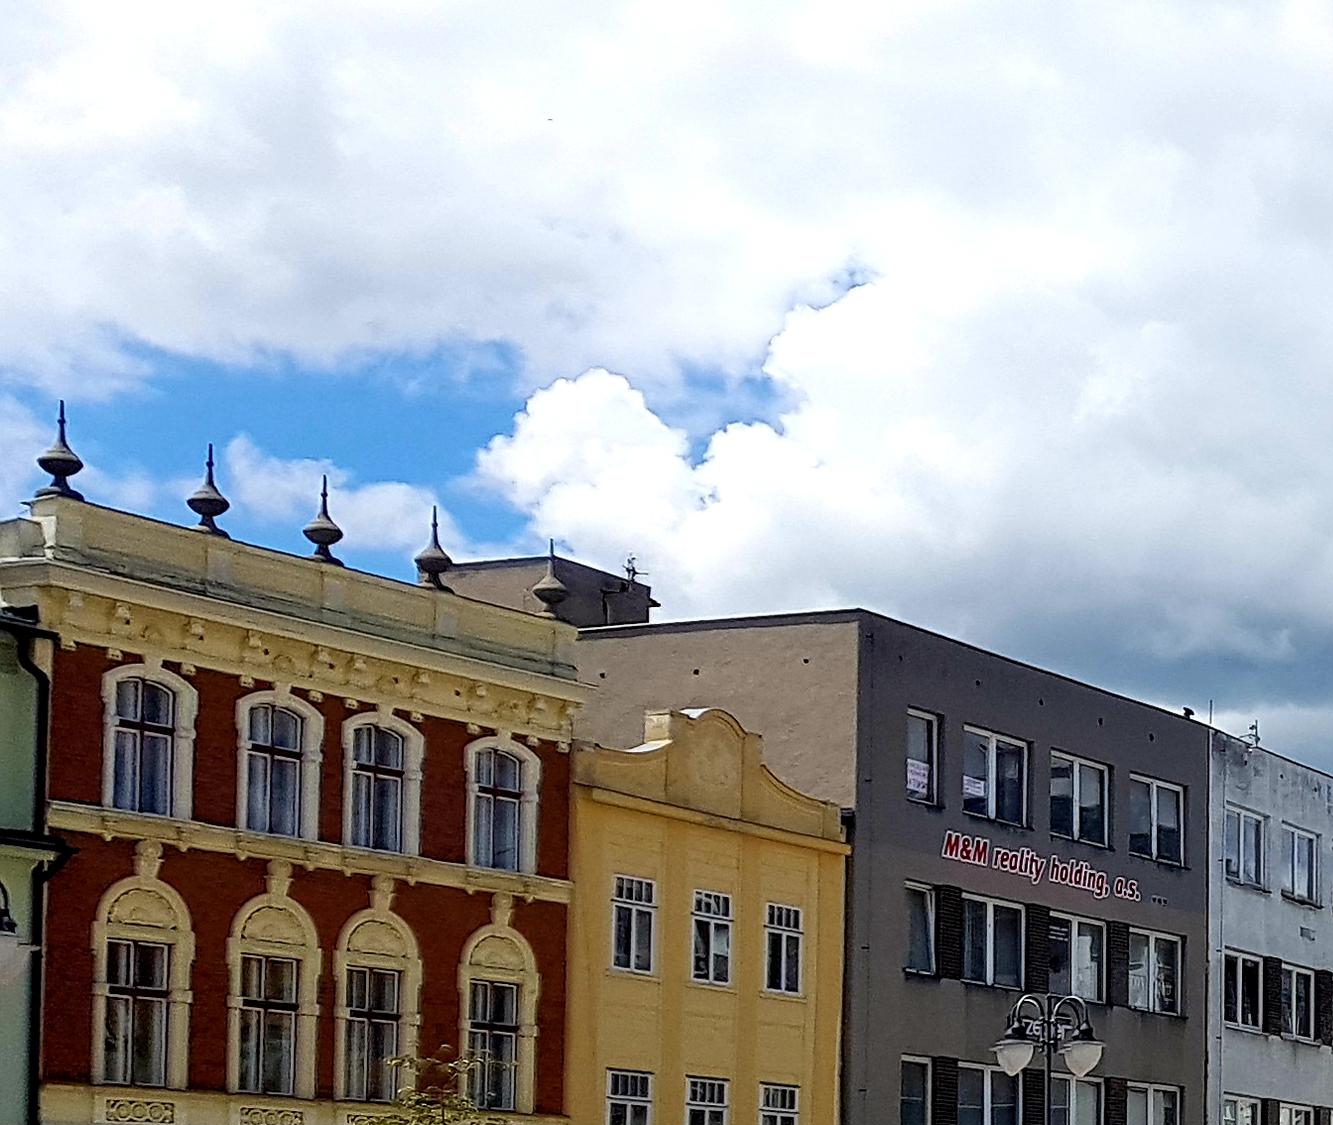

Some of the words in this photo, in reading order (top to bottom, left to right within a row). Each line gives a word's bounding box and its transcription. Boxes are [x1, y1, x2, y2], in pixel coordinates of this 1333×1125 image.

[942, 831, 990, 867] M&M
[992, 847, 1047, 884] reality
[1048, 855, 1111, 899] holding,
